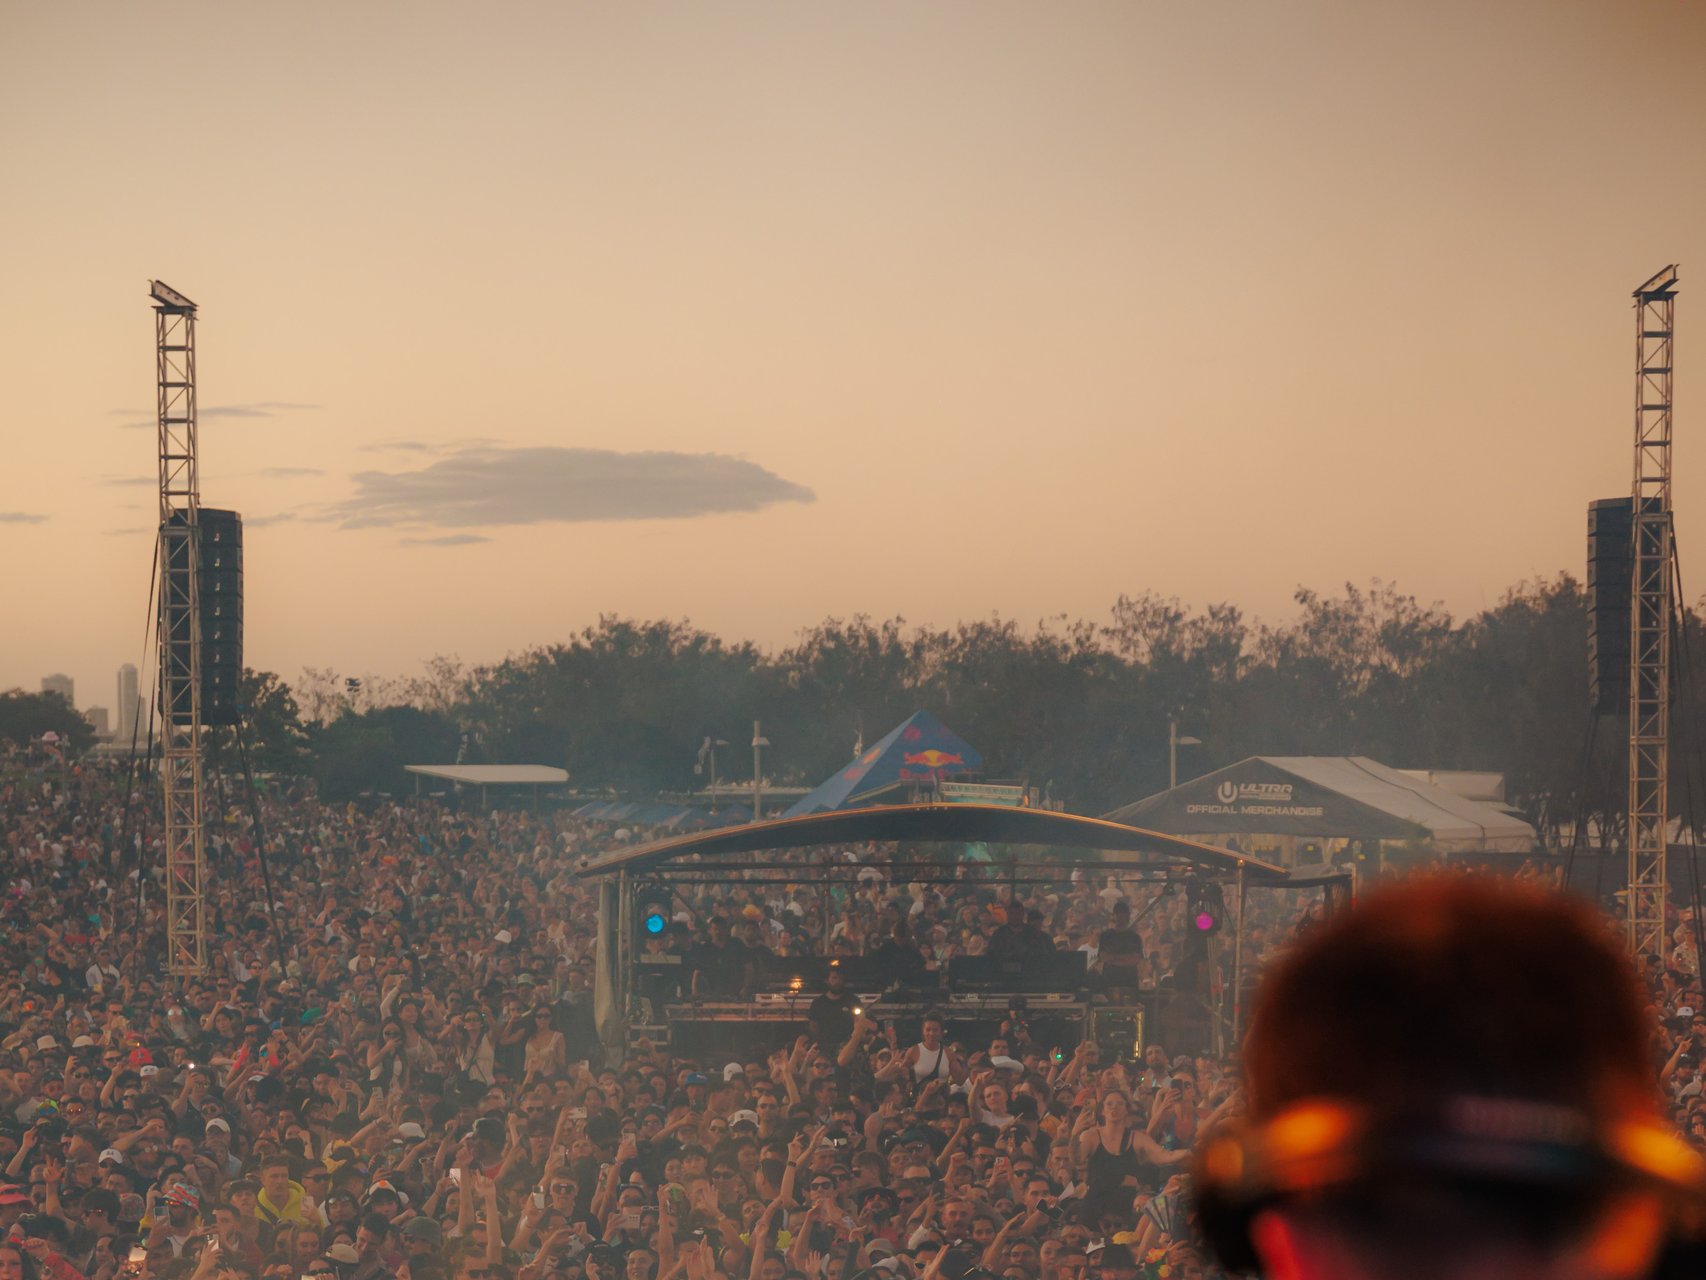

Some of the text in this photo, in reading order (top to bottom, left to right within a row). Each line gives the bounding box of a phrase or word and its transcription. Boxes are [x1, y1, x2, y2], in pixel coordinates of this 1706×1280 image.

[1239, 783, 1293, 794] ULTRA
[1187, 804, 1323, 816] OFFICIAL MERCHANDISE
